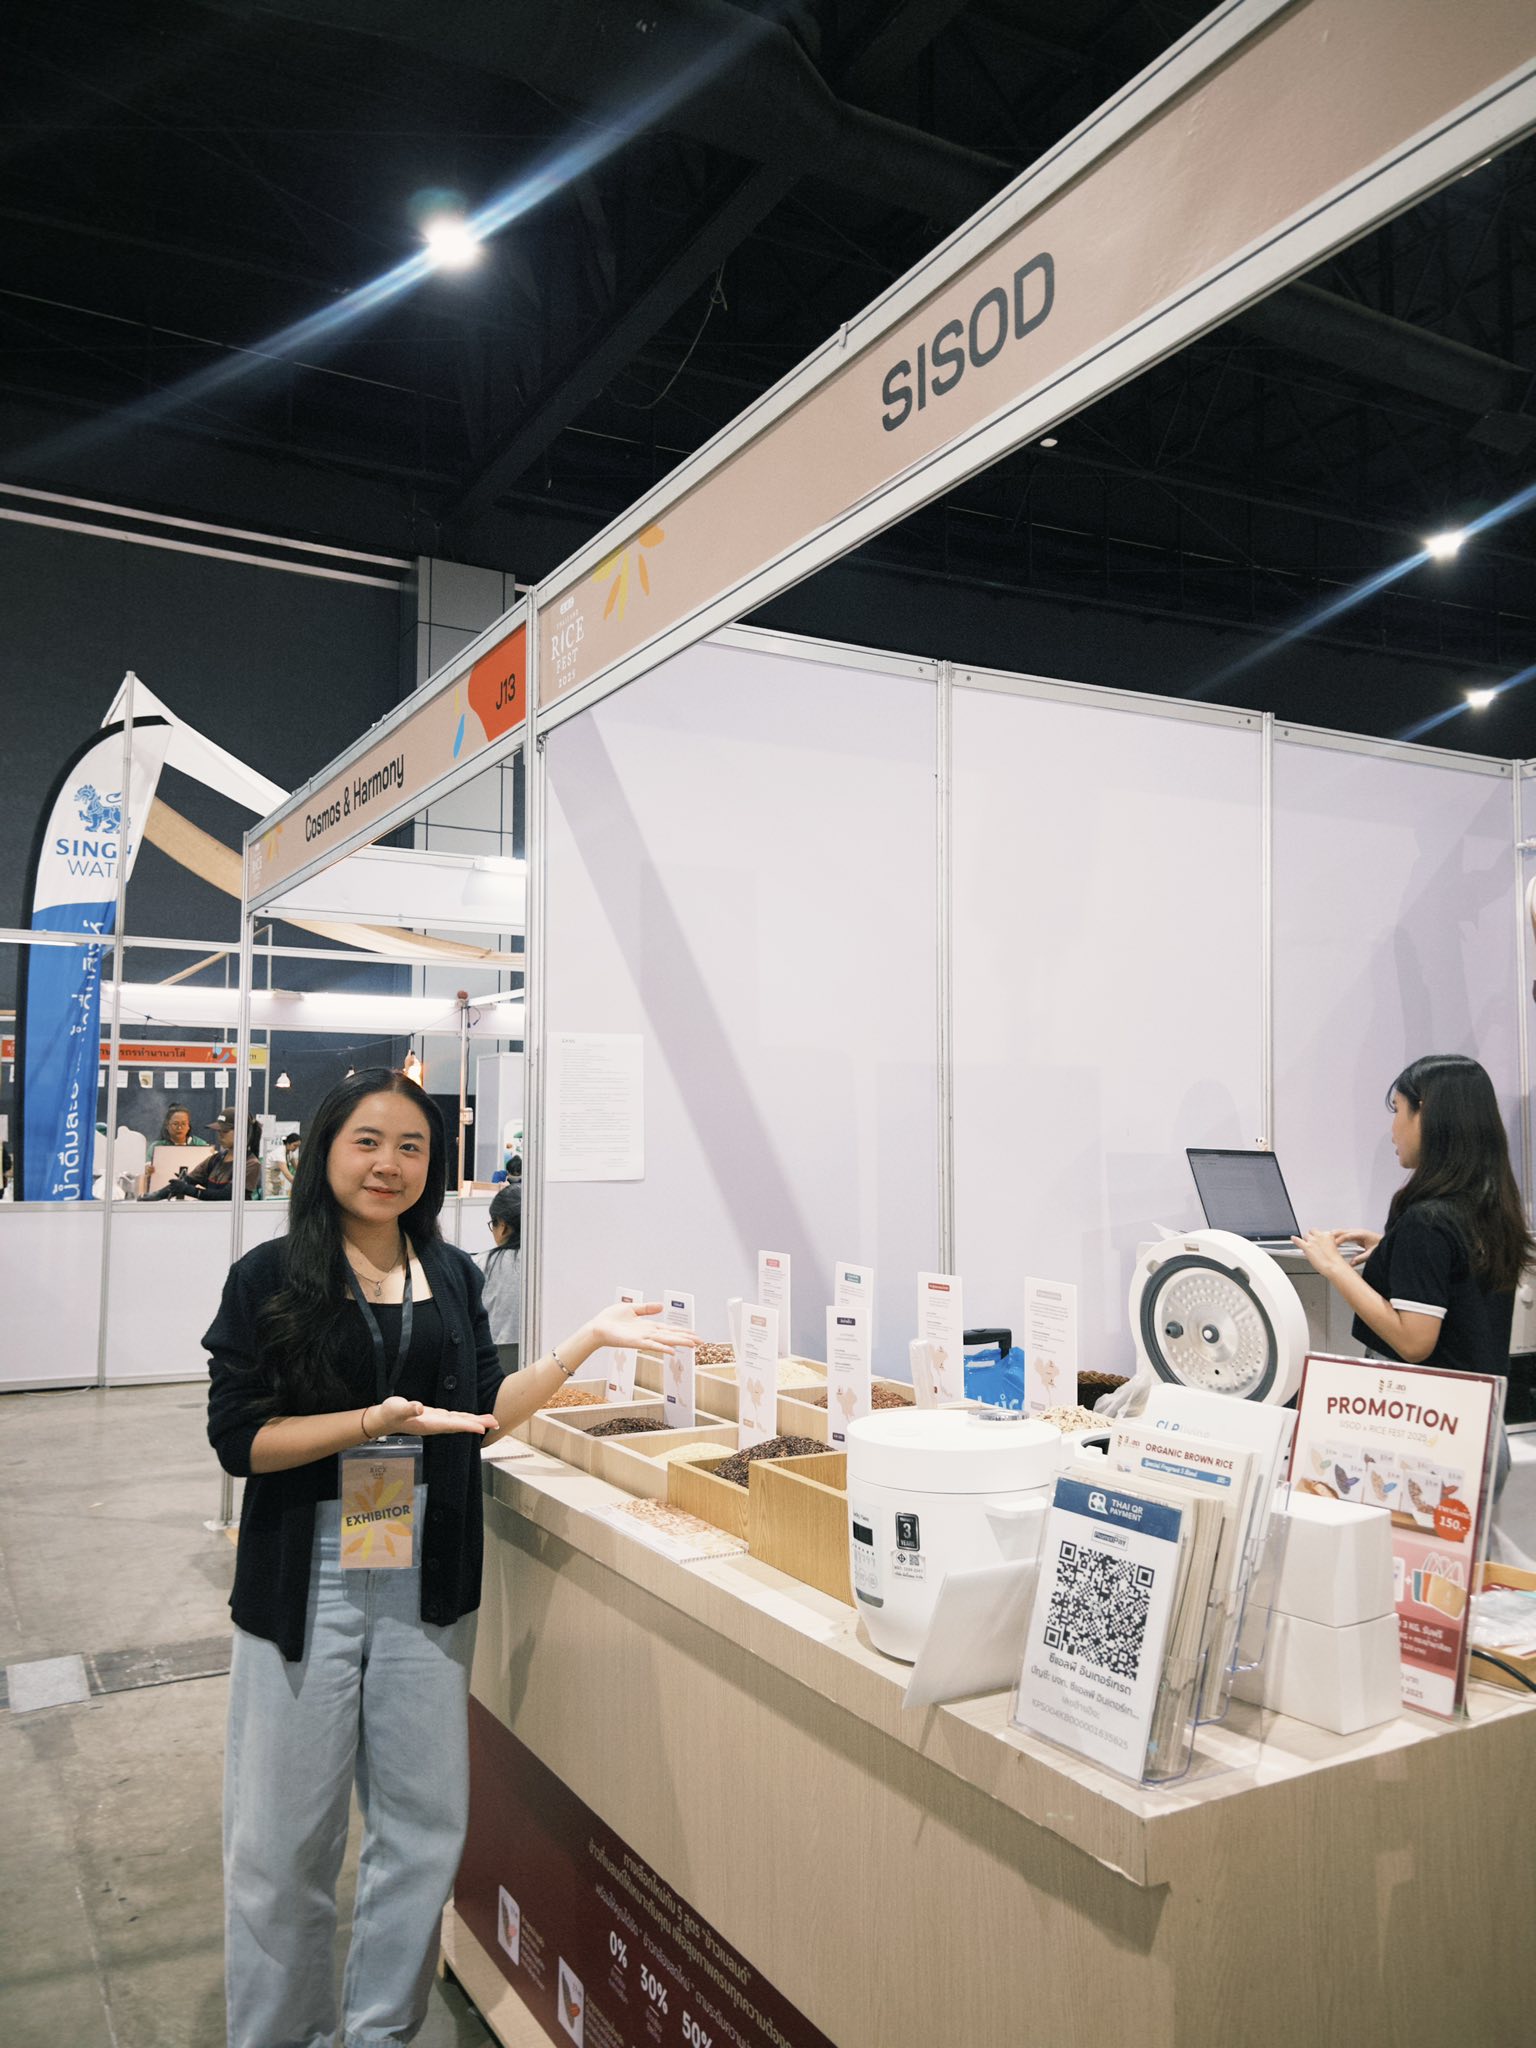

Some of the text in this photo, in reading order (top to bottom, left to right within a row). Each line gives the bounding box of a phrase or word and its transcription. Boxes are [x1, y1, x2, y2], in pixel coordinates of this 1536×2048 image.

[882, 251, 1055, 432] SISOD
[551, 616, 585, 661] RICE
[556, 646, 579, 674] FEST
[495, 672, 517, 711] J13
[305, 753, 405, 843] Cosmos & Harmony
[1327, 1397, 1459, 1435] PROMOTION
[1145, 1443, 1233, 1470] ORGANIC BROWN RICE
[346, 1504, 411, 1527] EXHIBITOR
[1110, 1507, 1142, 1522] PAYMENT
[1111, 1498, 1144, 1515] THAI QR
[1439, 1515, 1466, 1531] 150.-
[903, 1523, 912, 1539] 3
[677, 1904, 683, 1921] 5
[609, 1930, 628, 1969] 0%
[640, 1963, 669, 2015] 30%
[682, 2010, 713, 2048] 50%
